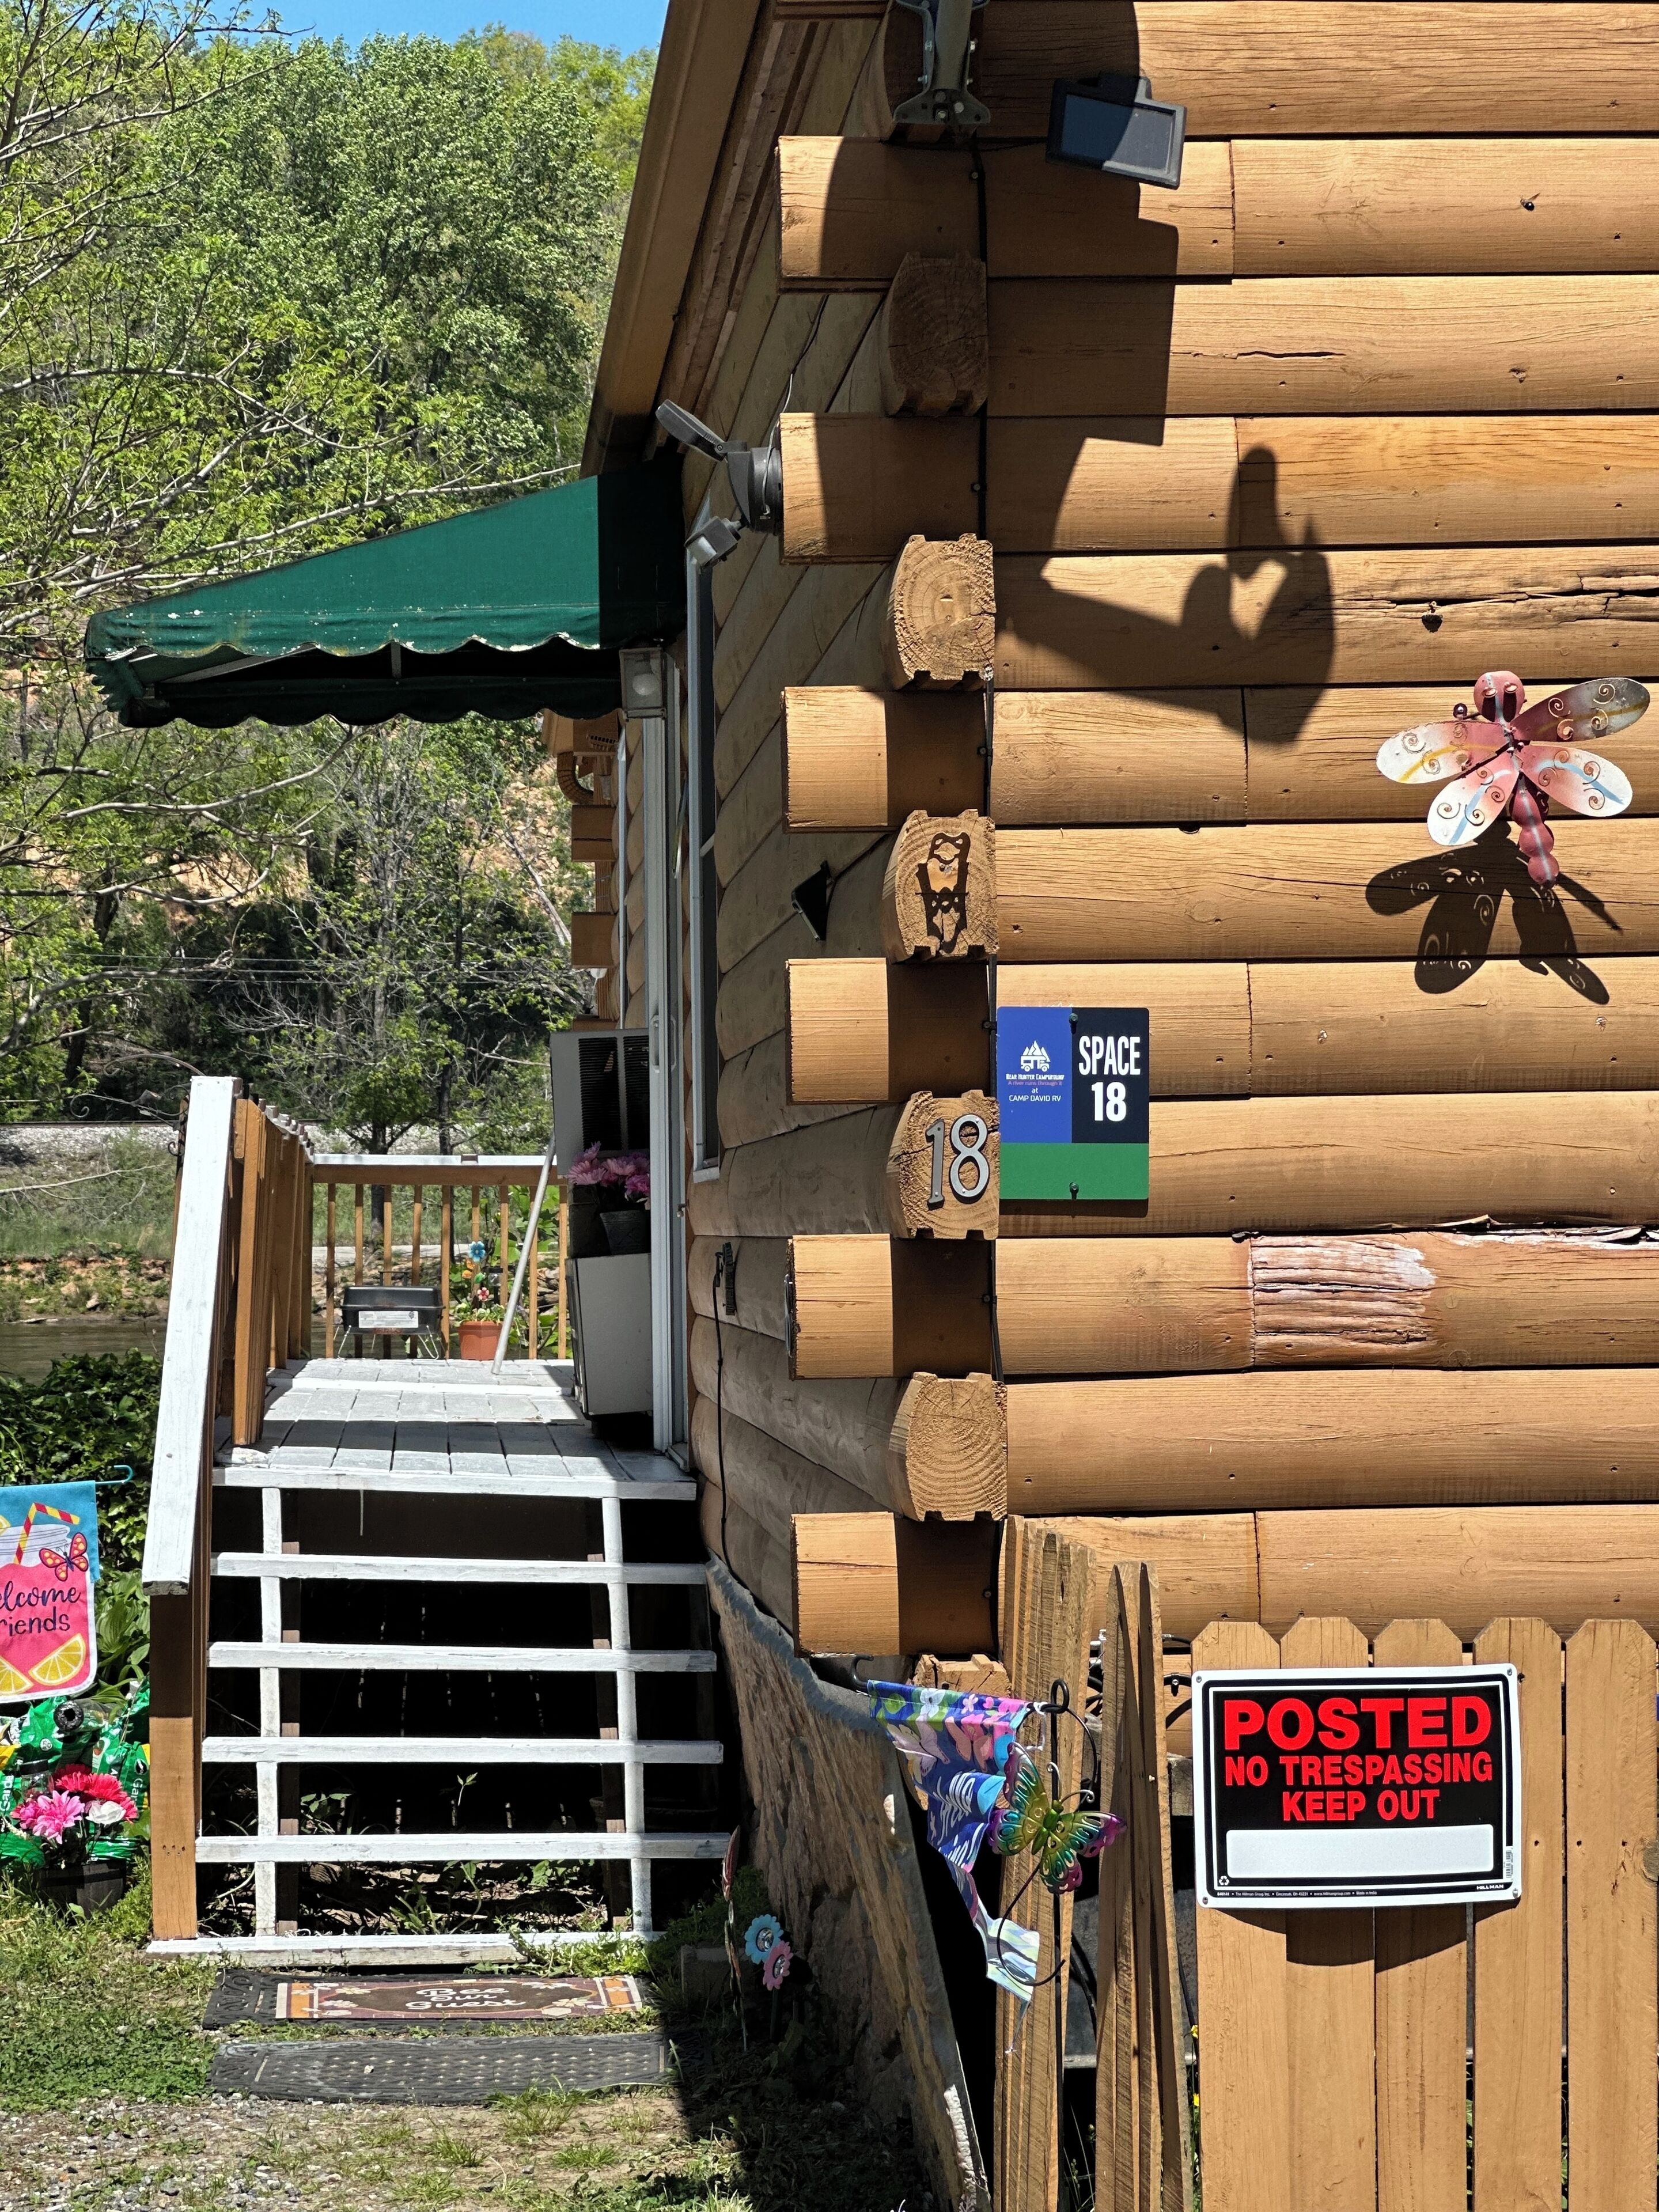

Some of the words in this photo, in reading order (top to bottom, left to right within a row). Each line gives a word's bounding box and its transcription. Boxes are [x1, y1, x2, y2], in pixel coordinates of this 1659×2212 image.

[1078, 1035, 1141, 1075] SPACE
[1090, 1081, 1127, 1122] 18
[926, 1113, 990, 1209] 18
[0, 1580, 82, 1612] lcome
[0, 1605, 70, 1637] riends
[1224, 1696, 1492, 1751] POSTED
[1225, 1756, 1268, 1786] NO
[1279, 1751, 1493, 1786] TRESPASSING
[1282, 1791, 1366, 1821] KEEP
[1377, 1789, 1440, 1820] OUT
[405, 1999, 527, 2010] Guest
[415, 1987, 510, 1997] Bee
[430, 1994, 498, 2002] Our
